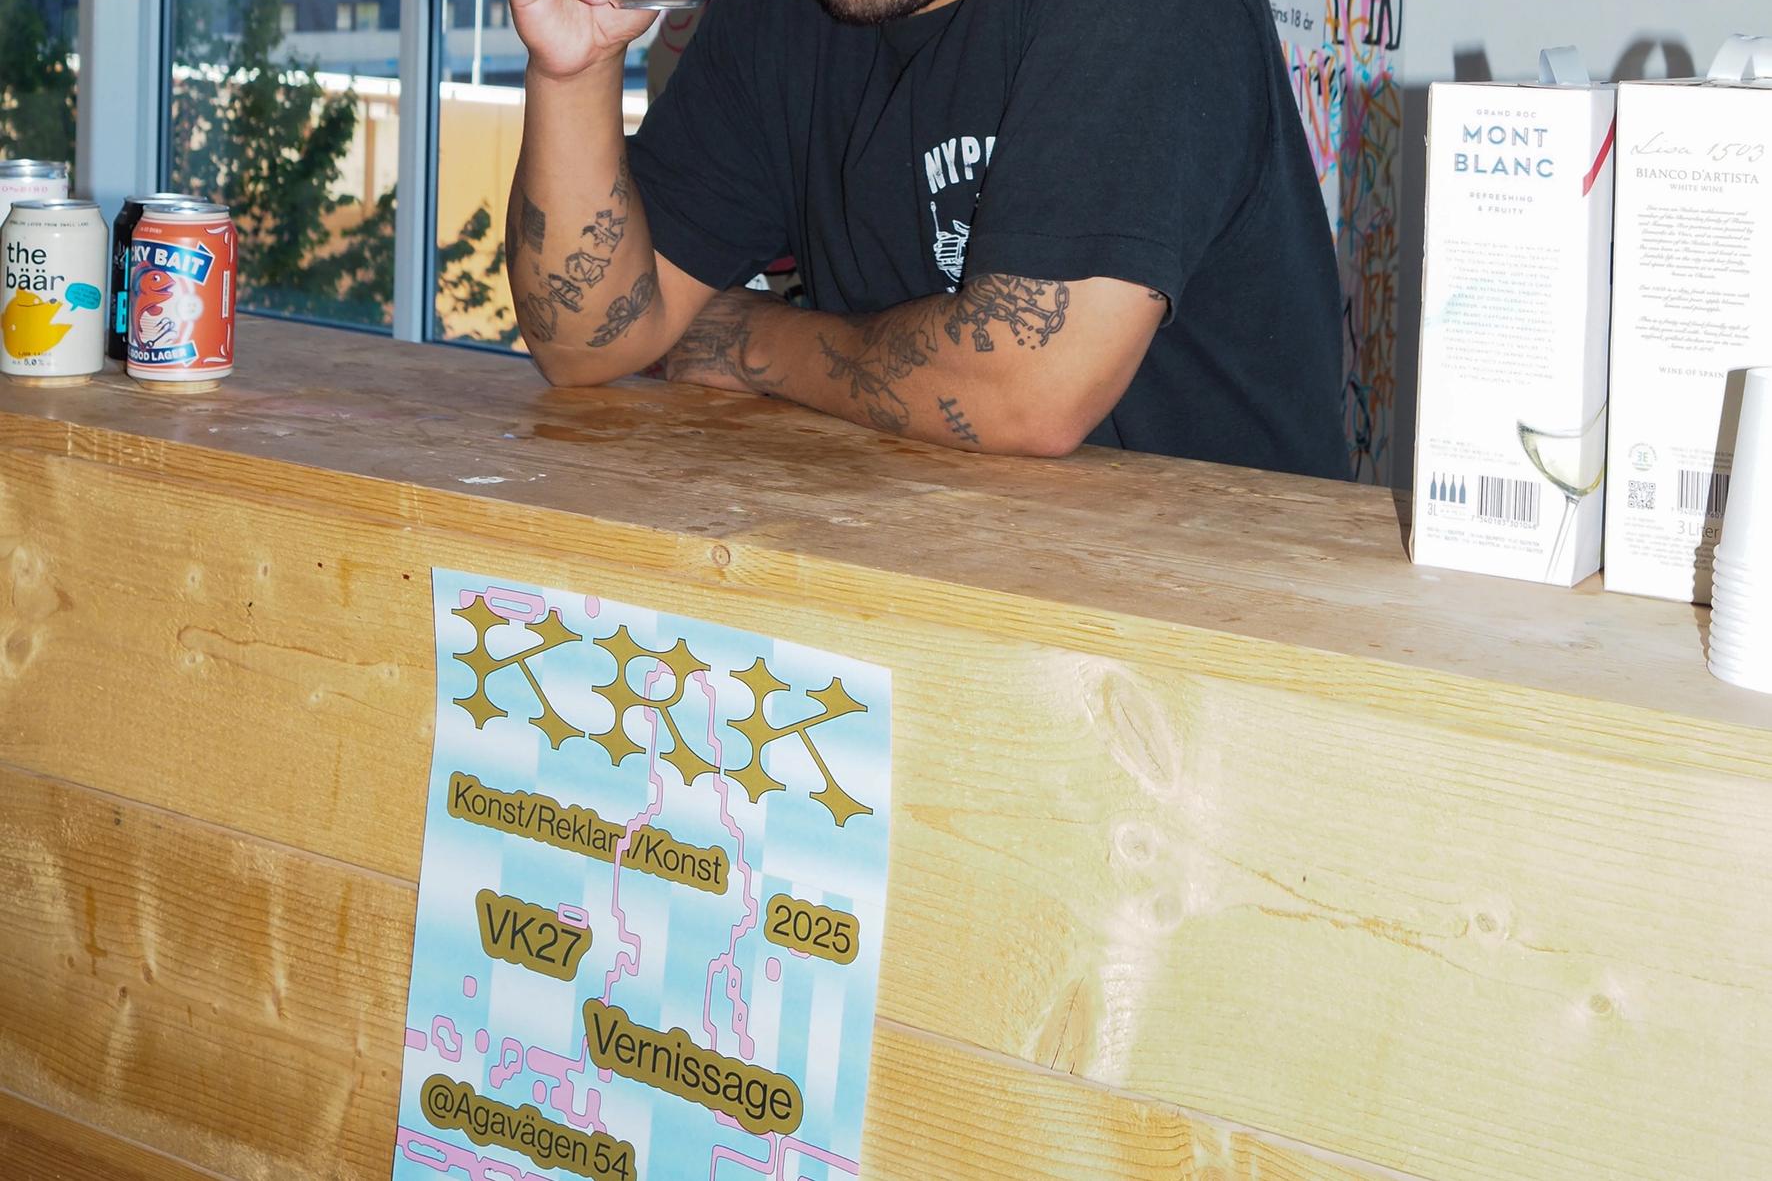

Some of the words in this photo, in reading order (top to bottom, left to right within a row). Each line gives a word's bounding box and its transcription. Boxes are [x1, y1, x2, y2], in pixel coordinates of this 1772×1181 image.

[1291, 7, 1301, 28] 18
[1476, 108, 1511, 117] GRAND
[1462, 124, 1548, 148] MONT
[1706, 141, 1765, 163] 1503
[1454, 153, 1554, 178] BLANC
[1635, 167, 1688, 180] BIANCO
[1692, 169, 1760, 185] D'ARTISTA
[1469, 191, 1533, 203] REFRESHING
[1669, 183, 1698, 192] WHITE
[1700, 184, 1724, 194] WINE
[1488, 206, 1524, 215] FRUITY
[7, 241, 47, 265] the
[154, 248, 205, 275] BAIT
[6, 266, 65, 291] bäär
[1658, 365, 1682, 376] WINE
[1685, 367, 1696, 377] OF
[1699, 369, 1725, 379] SPAIN
[1427, 502, 1438, 516] 3L
[1677, 520, 1685, 535] 3
[1689, 522, 1721, 539] Liter
[485, 903, 582, 967] VK27
[772, 904, 852, 954] 2025
[593, 1012, 793, 1122] Vernissage
[427, 1085, 588, 1168] @Agavägen
[593, 1143, 630, 1179] 54
